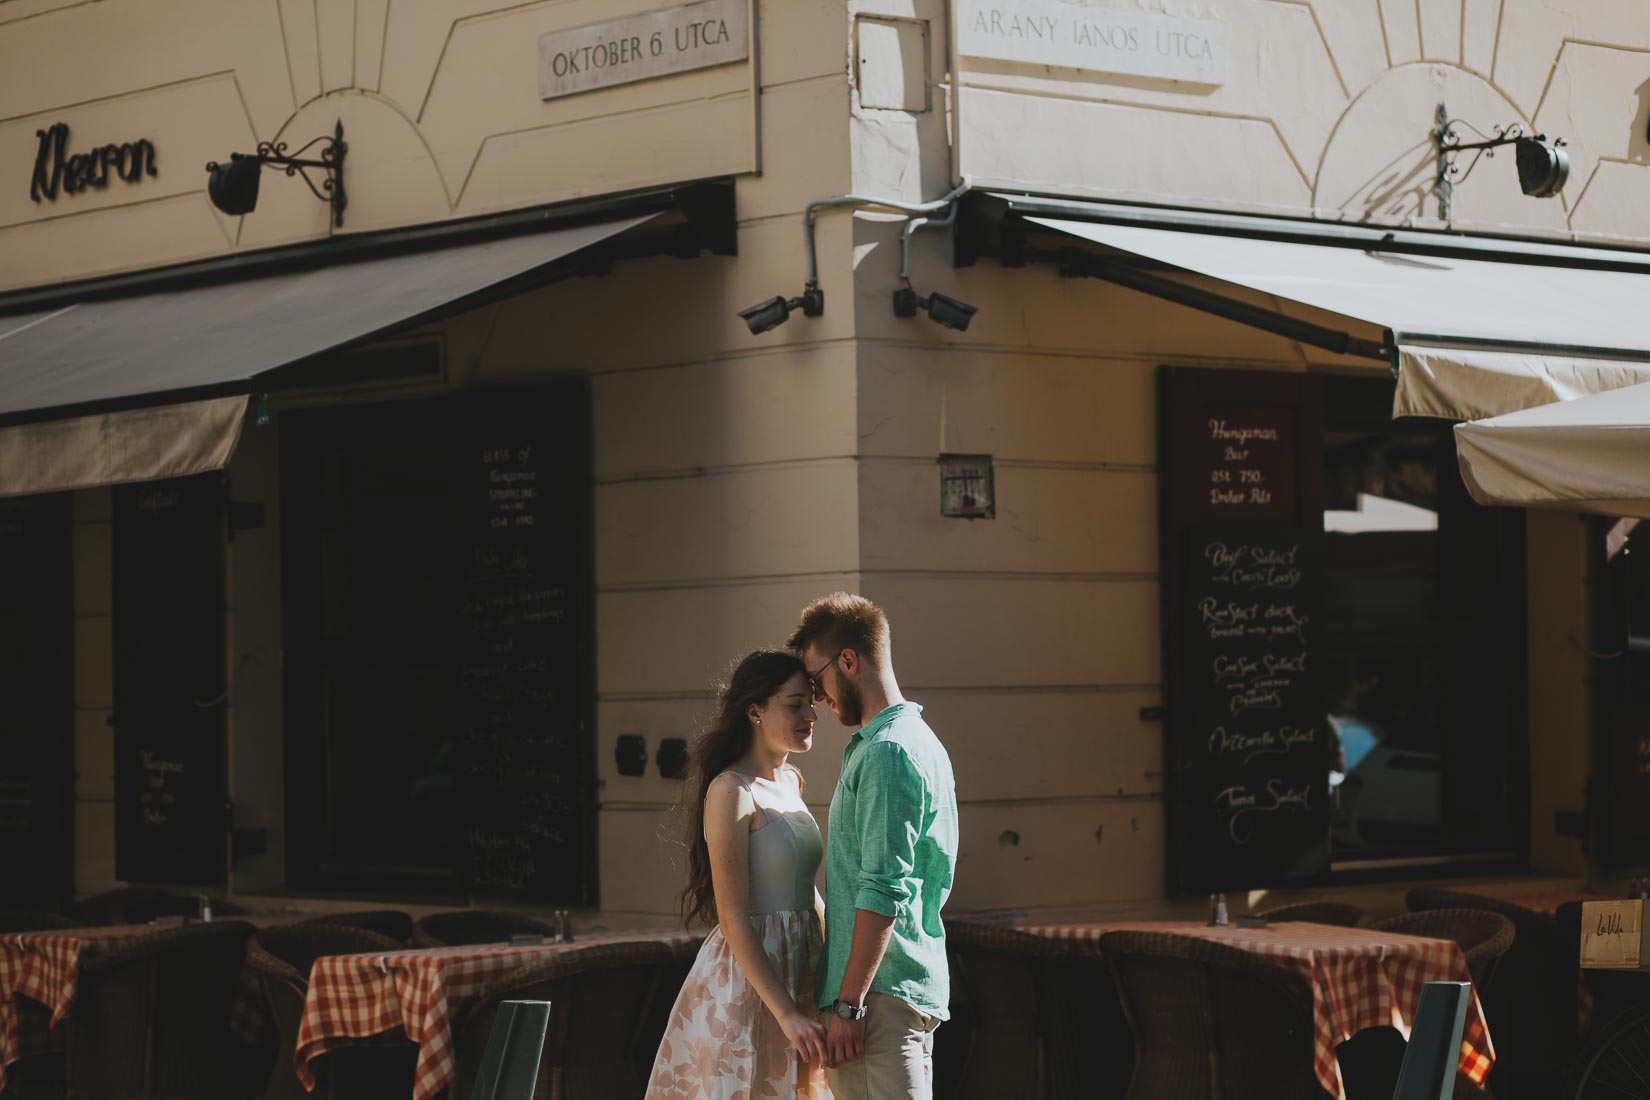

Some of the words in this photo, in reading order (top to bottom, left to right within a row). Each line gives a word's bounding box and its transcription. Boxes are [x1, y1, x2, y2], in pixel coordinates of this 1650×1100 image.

[649, 32, 662, 56] 6
[675, 19, 730, 51] UTCA
[973, 9, 1059, 42] ARANY
[1155, 30, 1213, 60] UTCA
